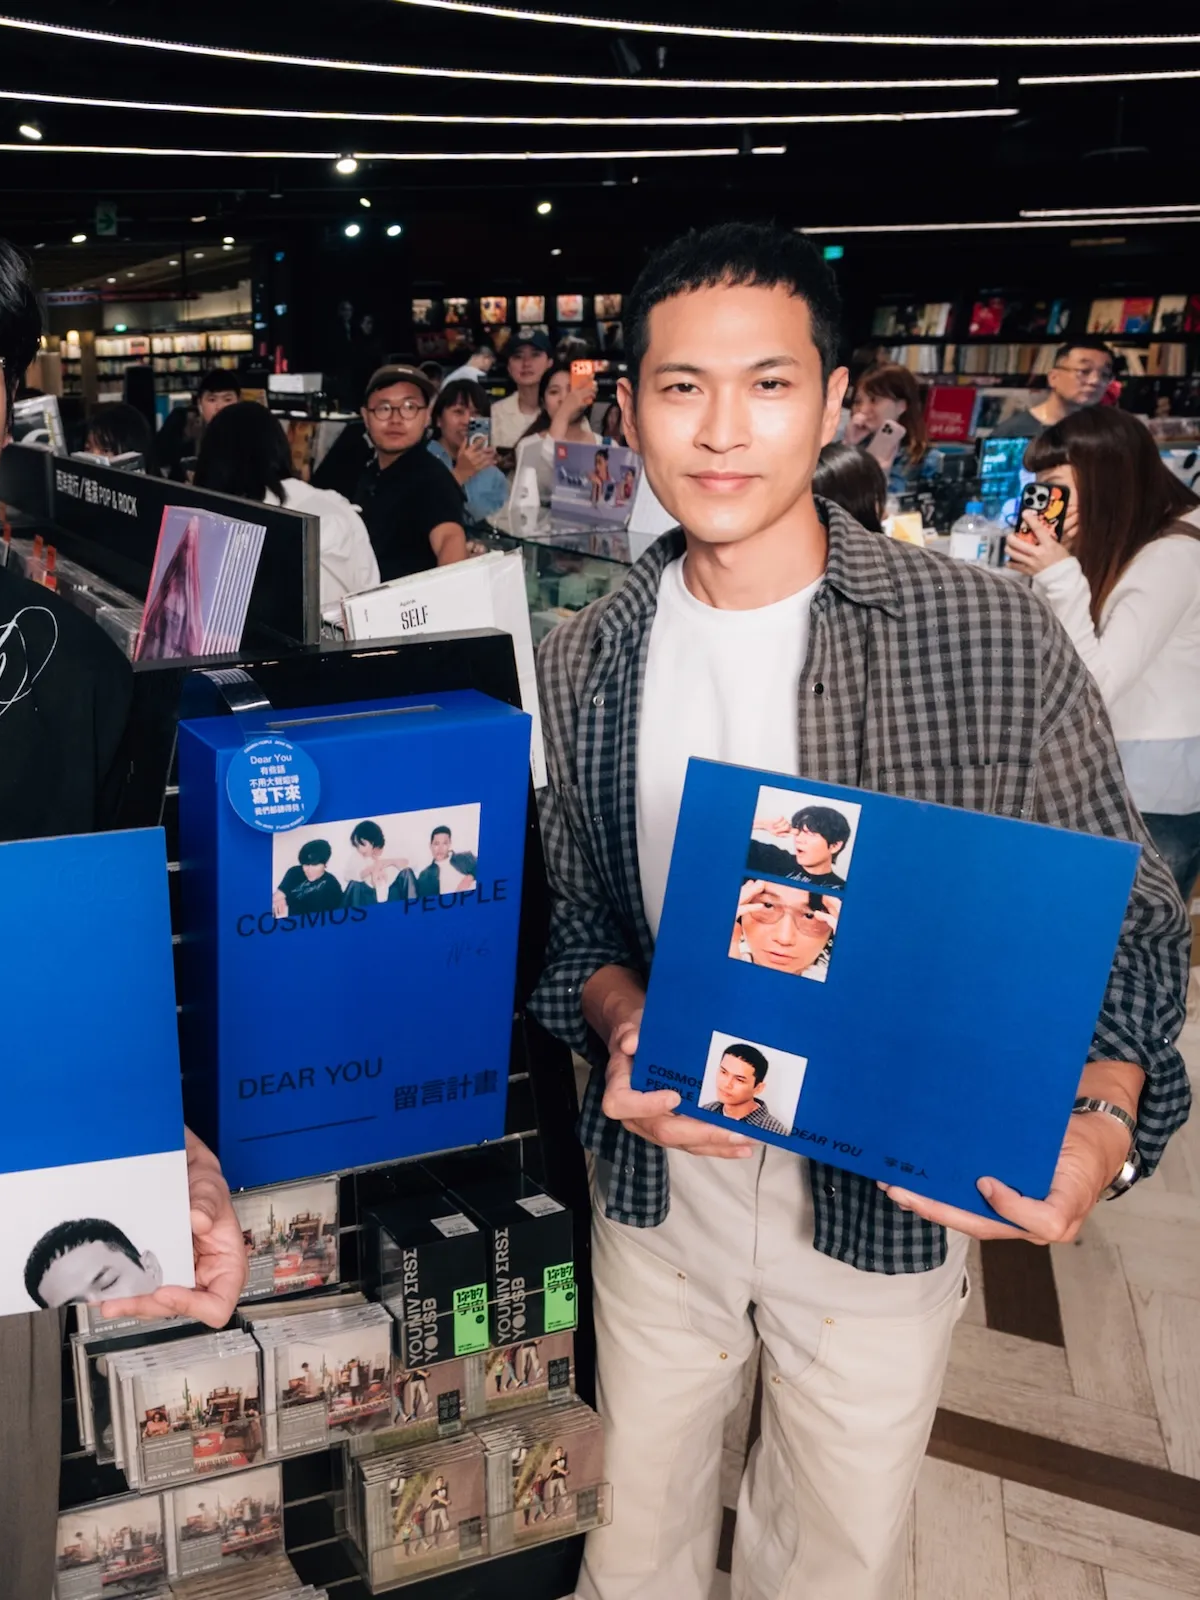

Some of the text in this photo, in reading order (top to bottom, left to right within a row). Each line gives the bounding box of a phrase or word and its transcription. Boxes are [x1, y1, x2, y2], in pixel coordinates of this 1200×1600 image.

[99, 486, 111, 506] POP
[118, 492, 138, 517] ROCK
[401, 604, 429, 630] SELF
[250, 753, 292, 765] Dear You
[251, 784, 301, 805] 寫下來
[236, 879, 508, 937] COSMOS PEOPLE
[238, 1056, 383, 1100] DEAR YOU
[393, 1069, 499, 1112] 留言計畫
[791, 1127, 863, 1157] DEAR YOU
